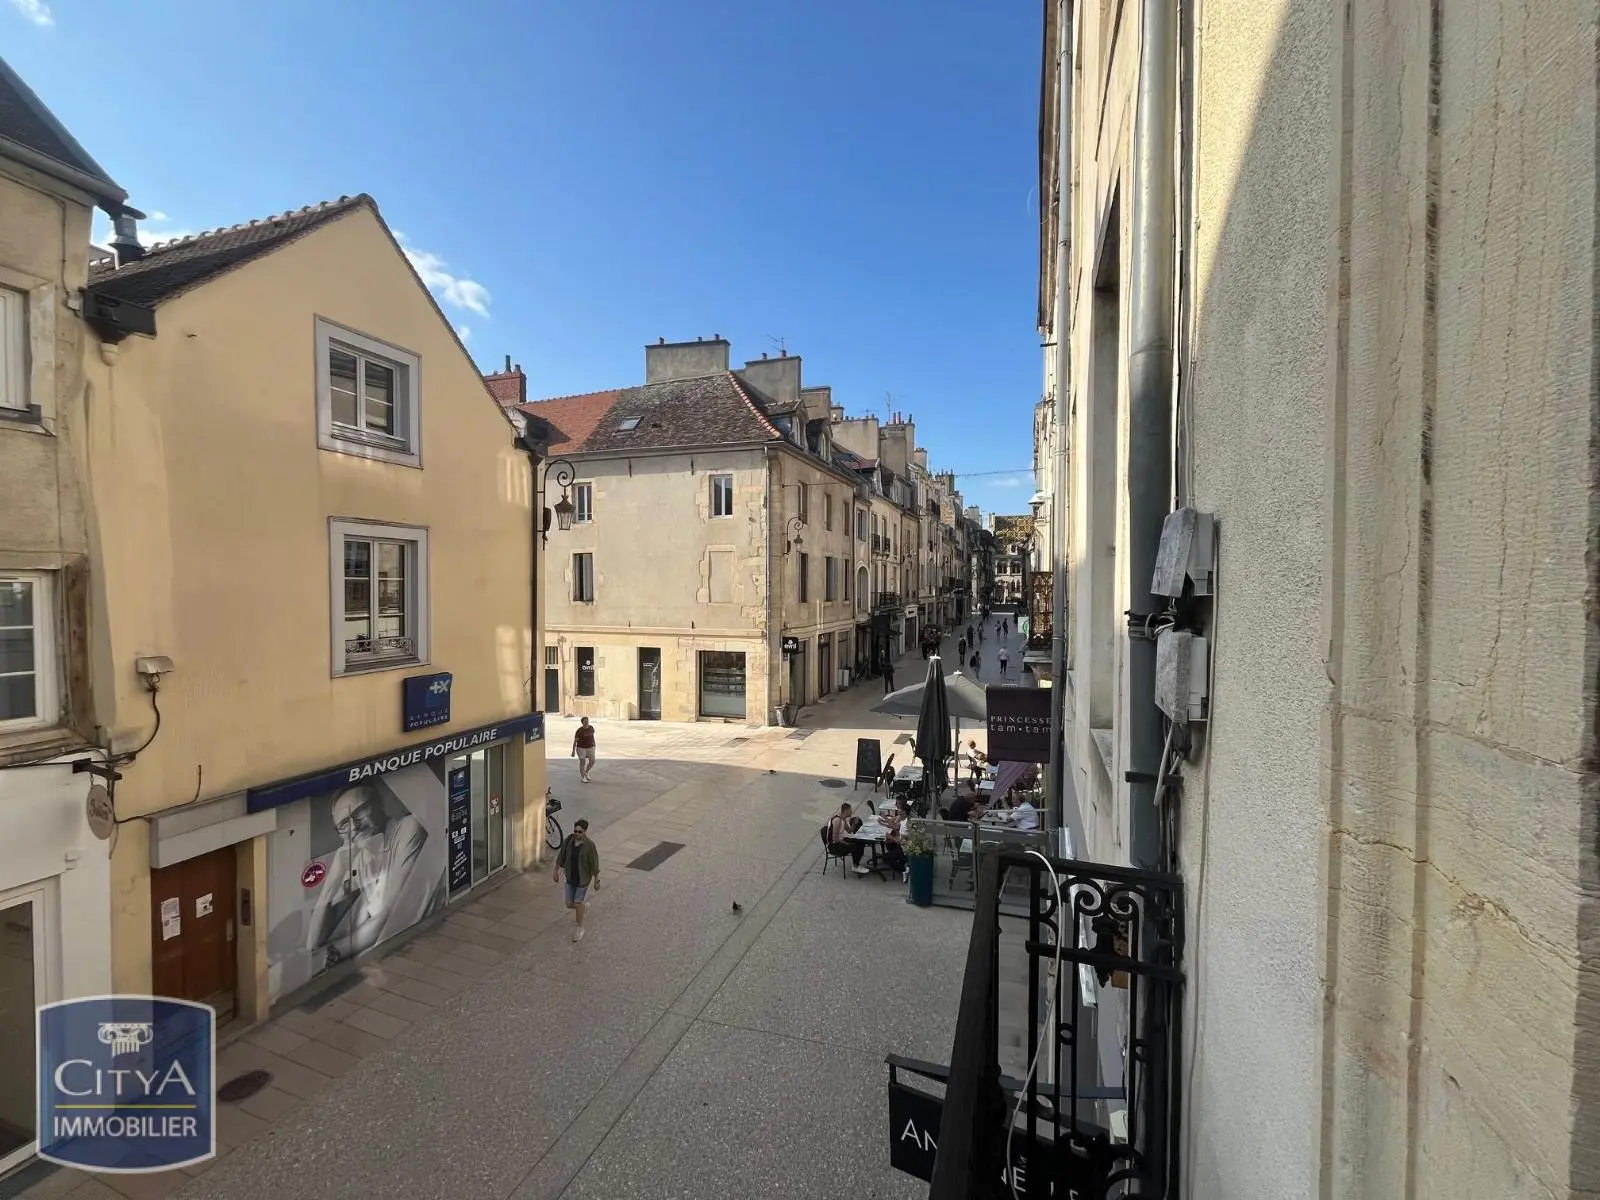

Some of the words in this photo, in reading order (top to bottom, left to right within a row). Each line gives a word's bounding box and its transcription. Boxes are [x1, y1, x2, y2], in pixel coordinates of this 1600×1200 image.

[410, 714, 448, 728] POPULAIRE
[348, 750, 422, 782] BANQUE
[424, 728, 498, 760] POPULAIRE
